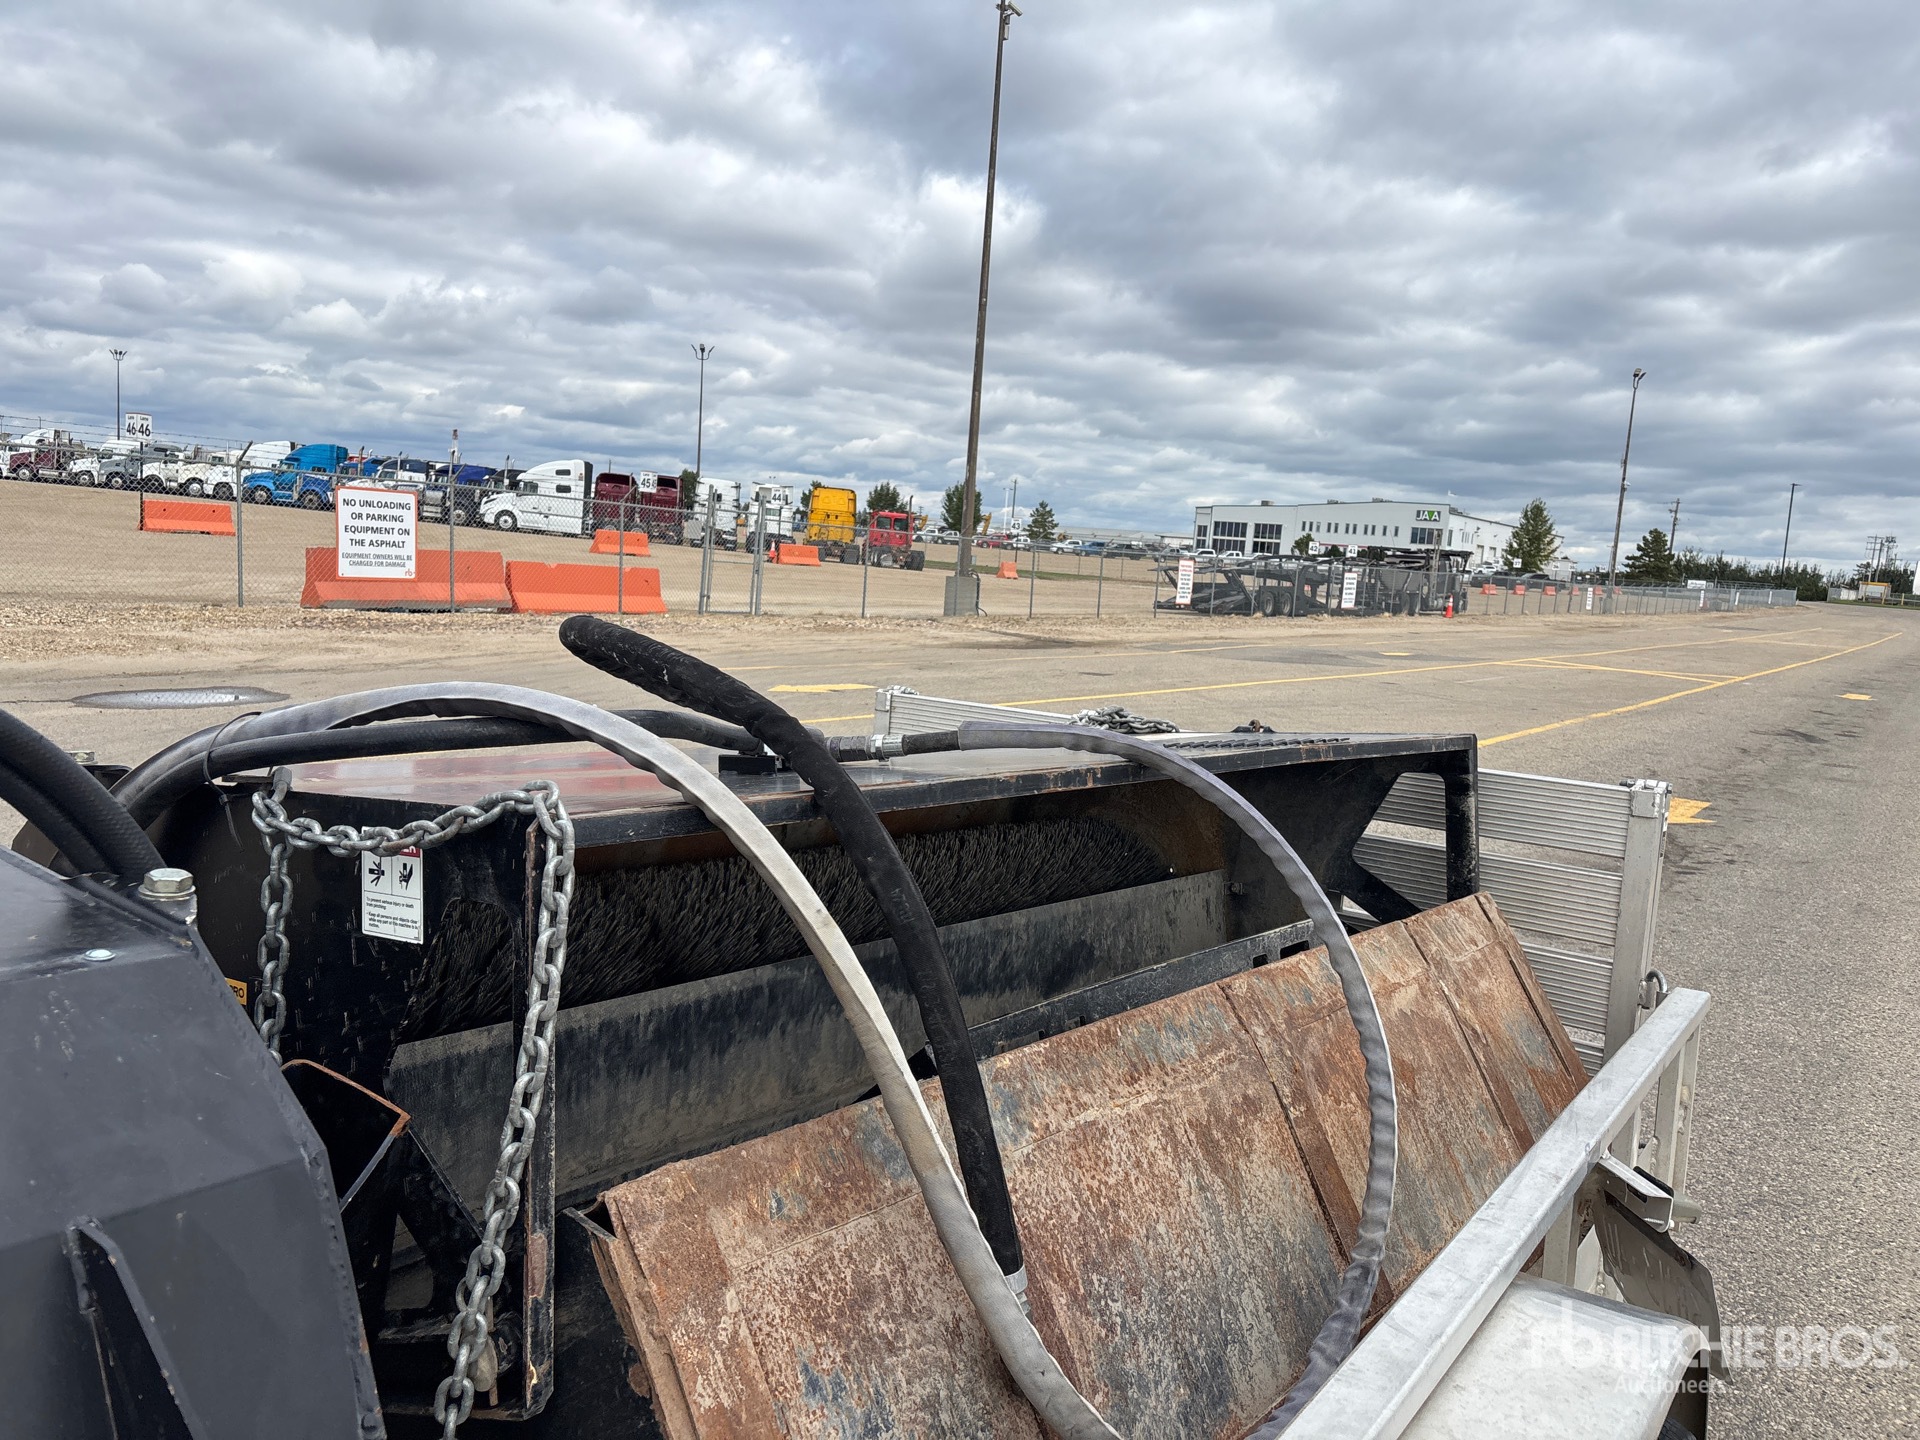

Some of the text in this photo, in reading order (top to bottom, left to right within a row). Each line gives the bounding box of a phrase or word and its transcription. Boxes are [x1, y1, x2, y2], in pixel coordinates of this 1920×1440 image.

[126, 422, 136, 436] 46
[138, 423, 150, 436] 46
[640, 478, 651, 488] 45
[772, 494, 781, 502] 44
[343, 498, 411, 510] NO UNLOADING
[351, 512, 404, 523] OR PARKING
[344, 525, 410, 536] EQUIPMENT ON
[349, 539, 406, 548] THE ASPHALT
[405, 568, 413, 576] rb
